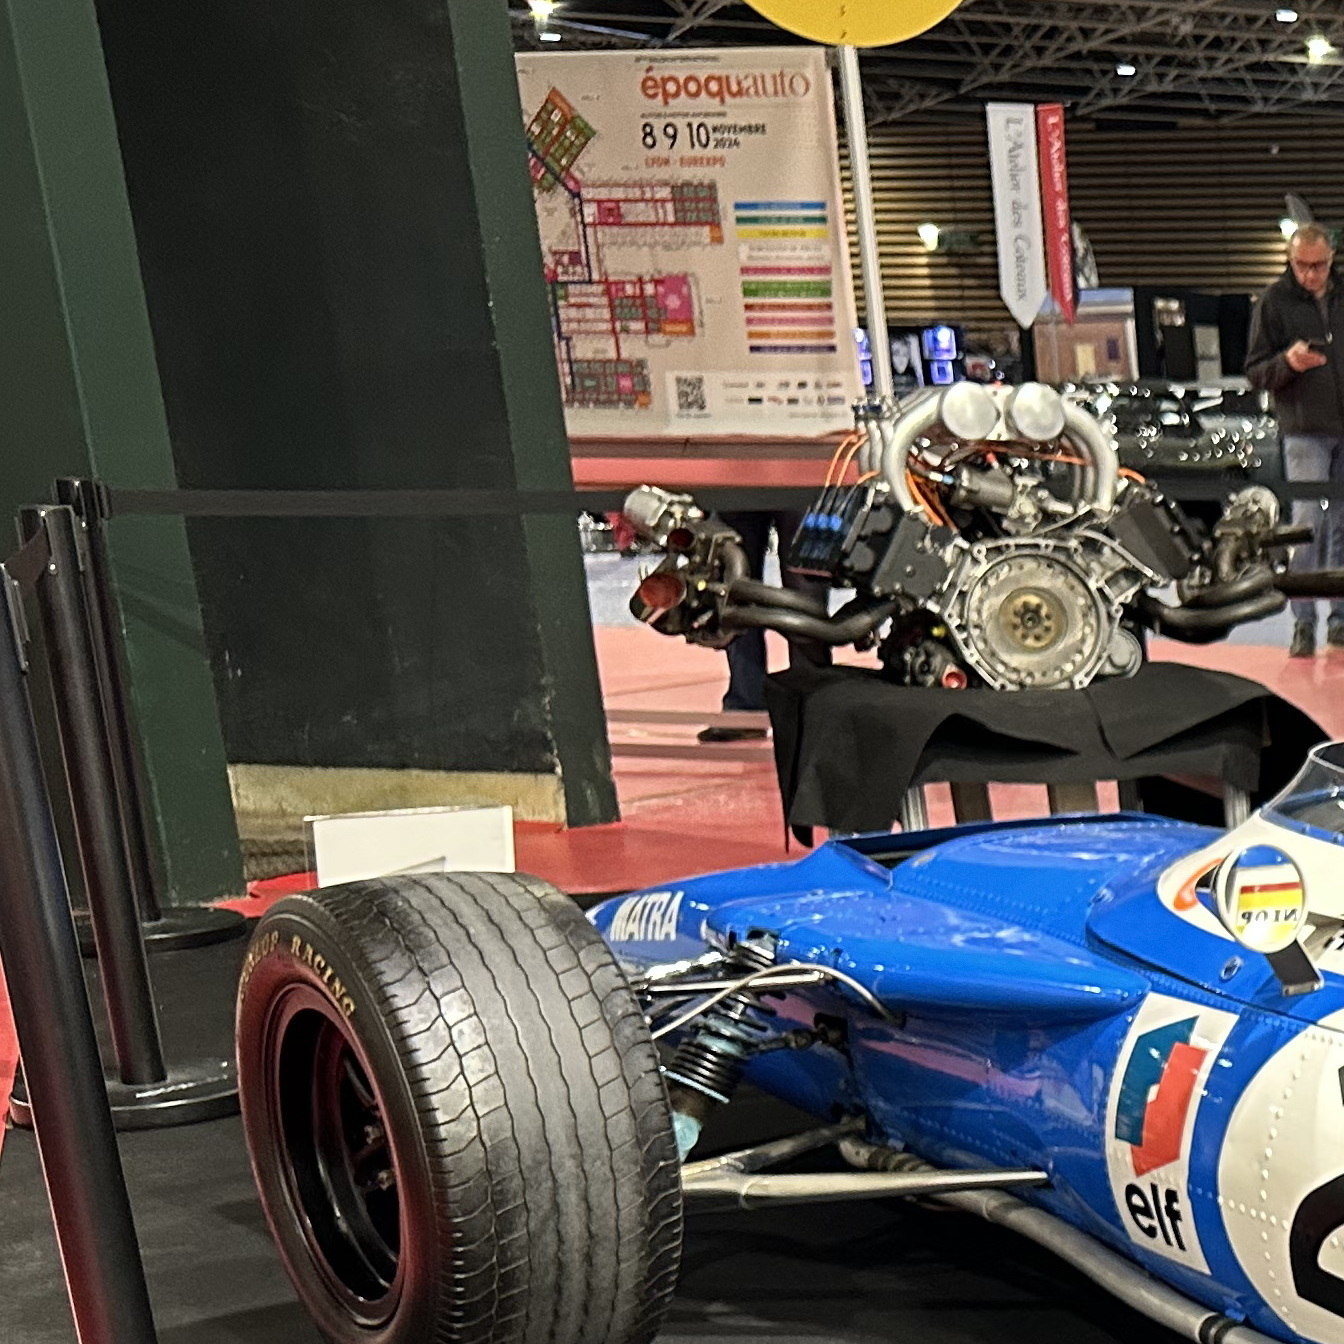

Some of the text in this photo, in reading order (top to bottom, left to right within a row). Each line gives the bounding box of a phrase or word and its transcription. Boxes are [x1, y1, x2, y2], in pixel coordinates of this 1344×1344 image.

[640, 65, 811, 107] époquauto
[641, 121, 658, 149] 8
[663, 122, 679, 149] 9
[686, 121, 711, 149] 10
[610, 890, 685, 942] MATRA
[290, 934, 357, 1017] RACING
[1124, 1182, 1188, 1252] elf
